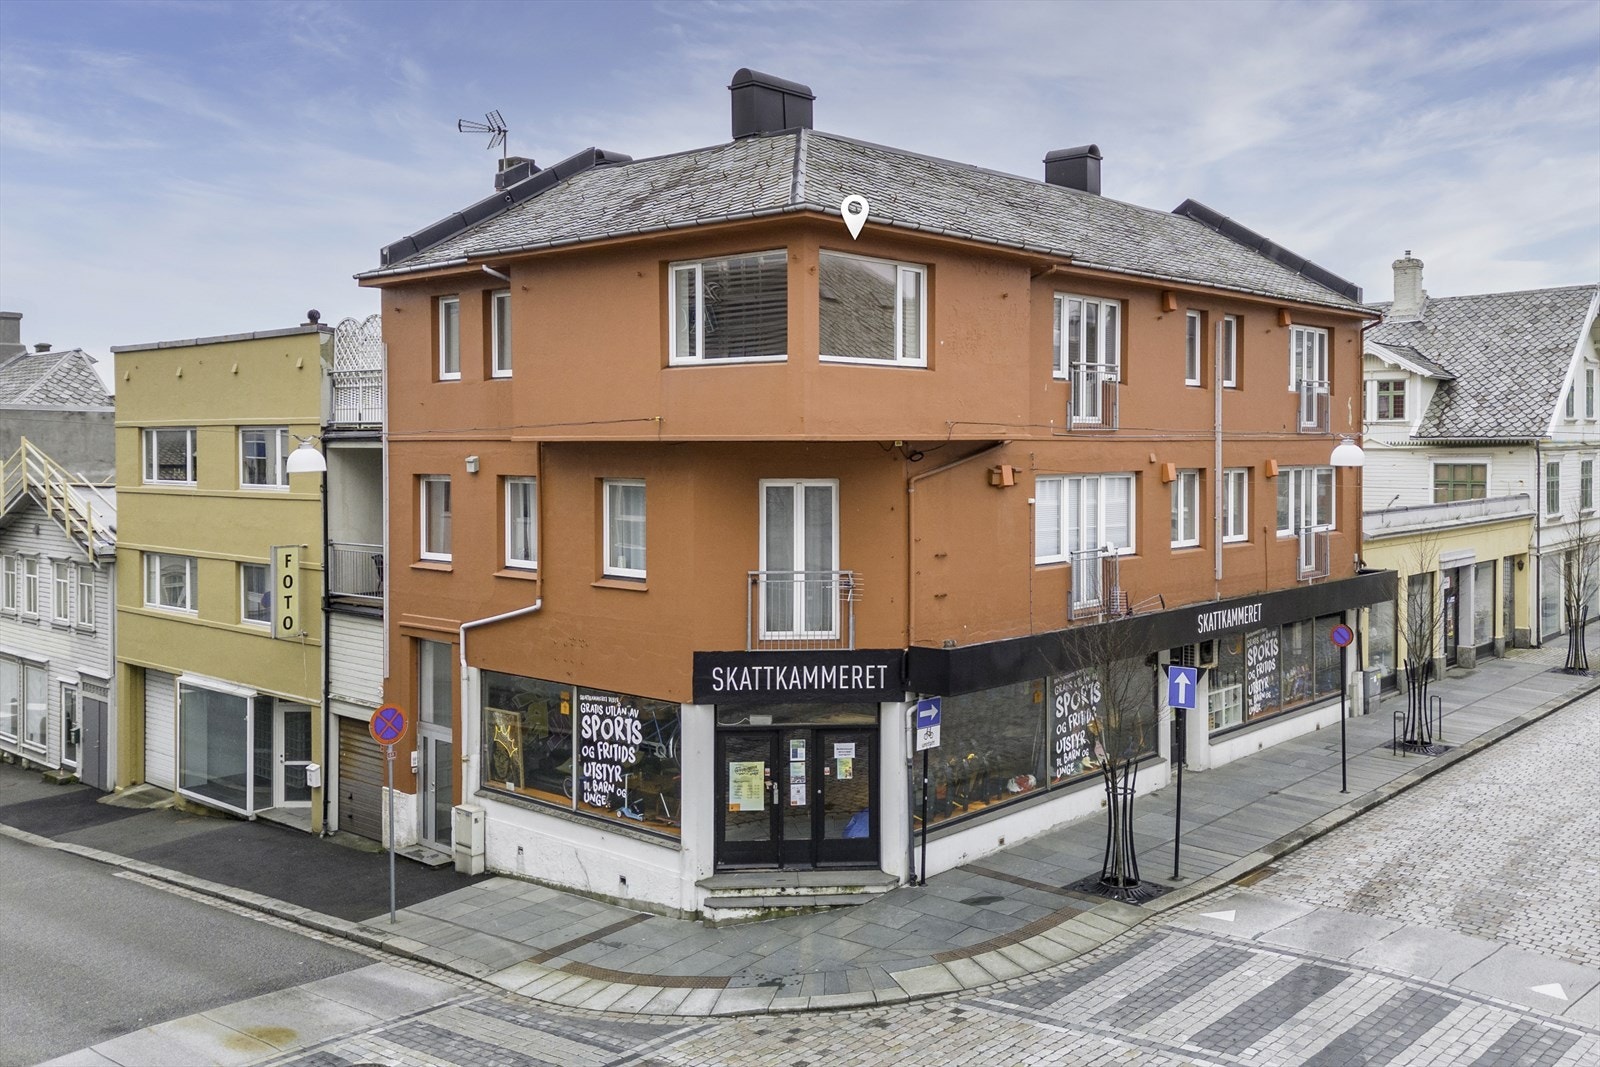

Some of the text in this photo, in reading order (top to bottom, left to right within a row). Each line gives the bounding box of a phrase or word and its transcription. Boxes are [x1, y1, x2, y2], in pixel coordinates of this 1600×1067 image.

[283, 554, 293, 630] FOTO
[1198, 603, 1262, 633] SKATTKAMMERET
[1248, 638, 1278, 666] SPORTS
[712, 665, 887, 691] SKATTKAMMERET
[581, 703, 639, 718] GRATIS UTLÅN AV
[1056, 681, 1101, 718] SPORTS
[582, 715, 643, 745] SPORTS
[1056, 722, 1067, 735] OG
[582, 741, 636, 763] OG FRITIDS
[1056, 731, 1086, 754] UTSTYR
[1063, 748, 1080, 763] BARN
[1082, 748, 1089, 757] OG
[583, 763, 622, 782] UTSTYR
[1056, 762, 1074, 778] UNGE
[583, 780, 627, 798] TIL BARN OG
